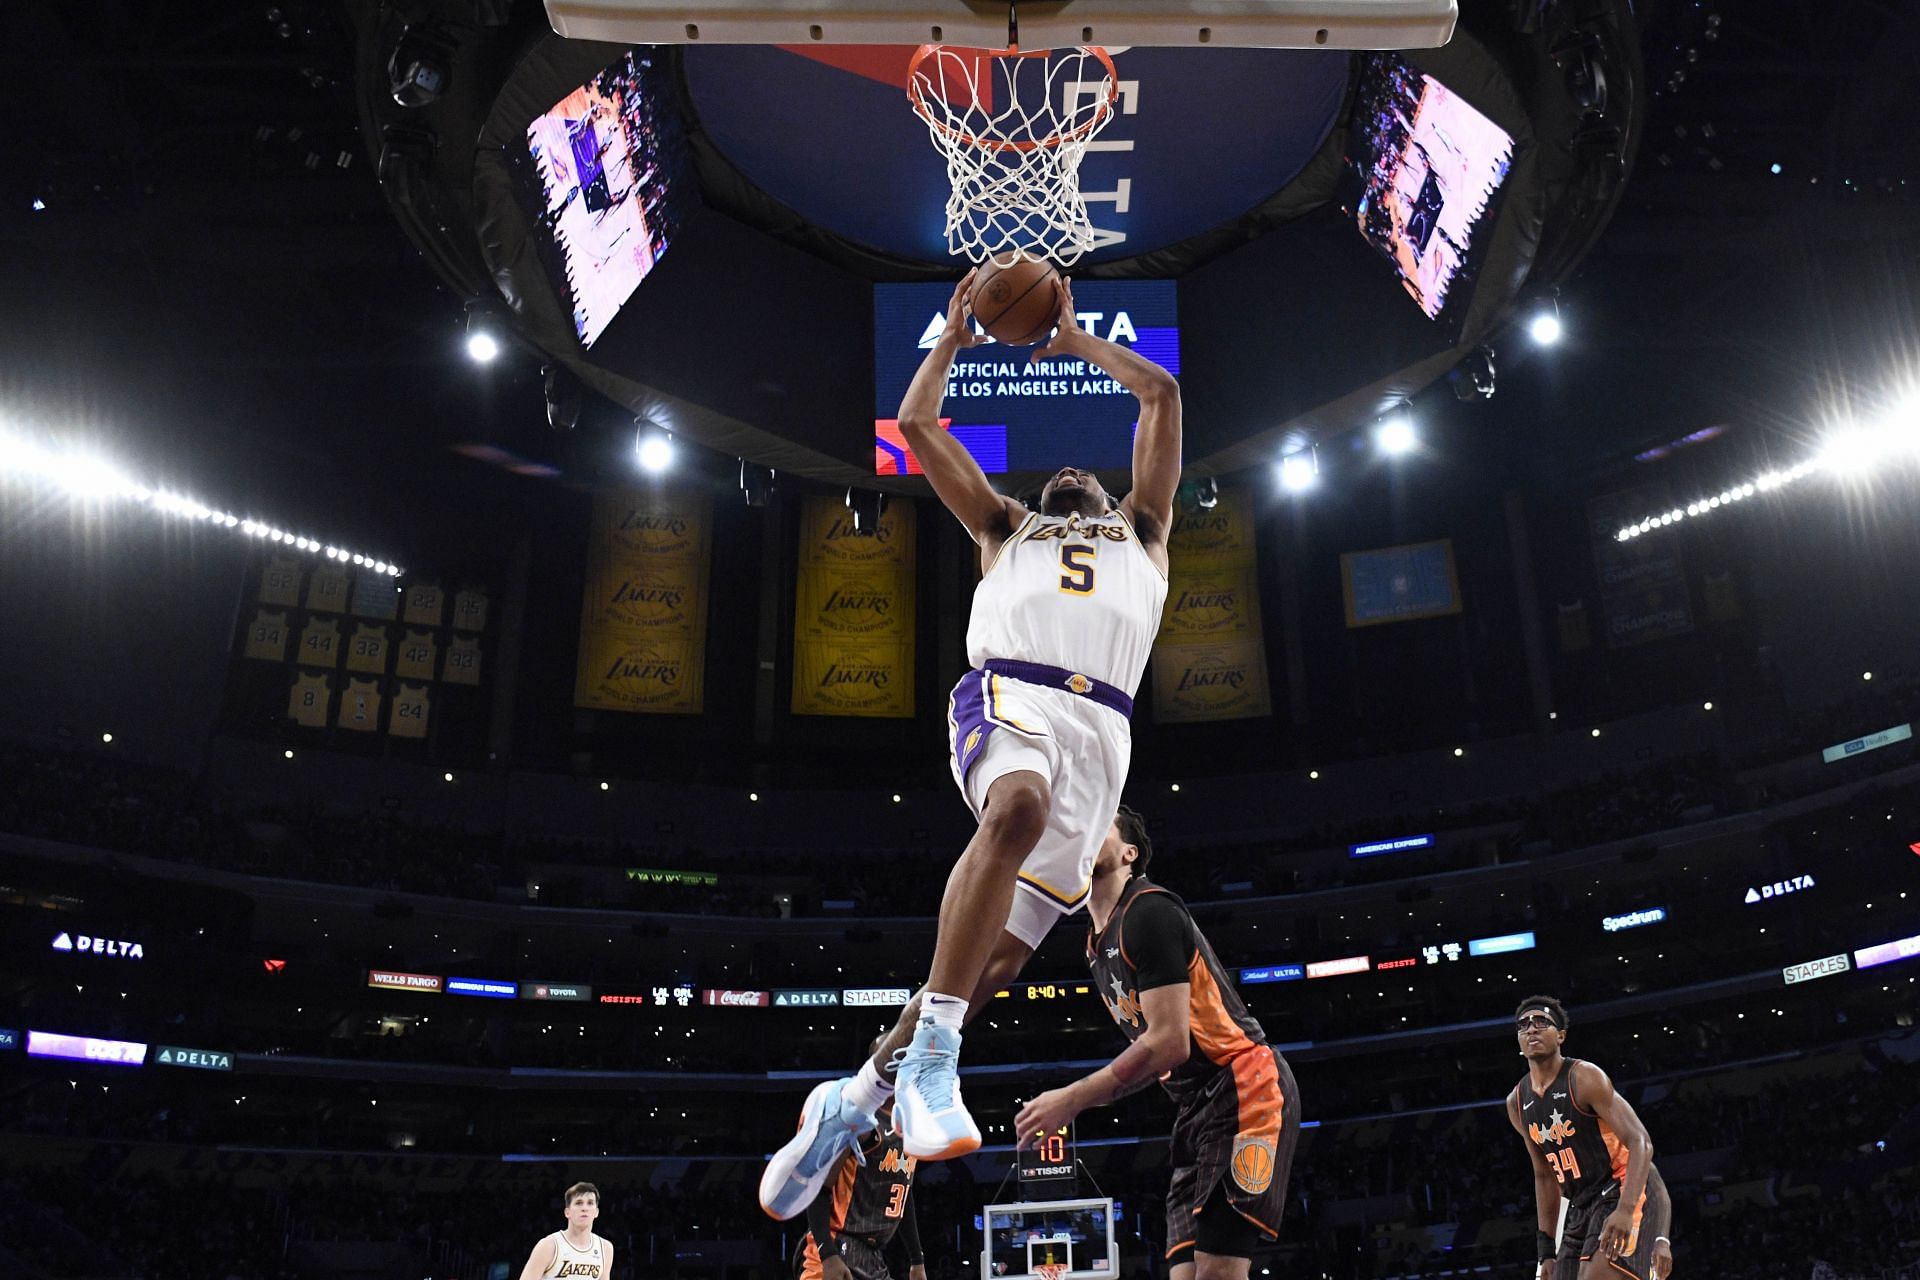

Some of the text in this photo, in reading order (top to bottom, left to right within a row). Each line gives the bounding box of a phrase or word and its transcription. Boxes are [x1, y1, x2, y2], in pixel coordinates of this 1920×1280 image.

[1059, 46, 1140, 257] ELTA
[949, 361, 1107, 378] OFFICIAL AIRLINE O
[962, 382, 992, 397] LOS
[996, 381, 1068, 396] ANGELES
[620, 510, 688, 537] LAKERS
[1058, 543, 1096, 597] 5
[413, 593, 434, 610] 22
[611, 580, 685, 609] LAKERS
[822, 591, 890, 615] LAKERS
[1173, 590, 1234, 611] LAKERS
[255, 627, 279, 645] 34
[307, 635, 331, 652] 44
[356, 640, 380, 657] 32
[405, 647, 429, 663] 42
[605, 656, 680, 686] LAKERS
[819, 664, 890, 689] LAKERS
[1176, 667, 1247, 692] LAKERS
[304, 691, 315, 706] 8
[399, 704, 422, 719] 24
[1762, 875, 1815, 899] DELTA
[1602, 909, 1663, 932] Spectrum
[76, 934, 144, 960] DELTA
[1377, 958, 1417, 970] ASSISTS
[1785, 956, 1847, 983] STAPLES
[374, 974, 438, 987] WELLS FARGO
[1273, 968, 1301, 978] ULTRA
[449, 982, 484, 992] AMERICAN
[549, 988, 577, 997] TOYOTA
[652, 987, 693, 998] LAL ORL
[1027, 985, 1056, 1000] 8:40
[600, 995, 643, 1004] ASSISTS
[790, 993, 839, 1005] DELTA
[845, 991, 908, 1004] STAPLES
[176, 1051, 229, 1068] DELTA
[1035, 1166, 1073, 1176] TISSOT
[1545, 1147, 1582, 1184] 34
[555, 1260, 601, 1279] LAKERS
